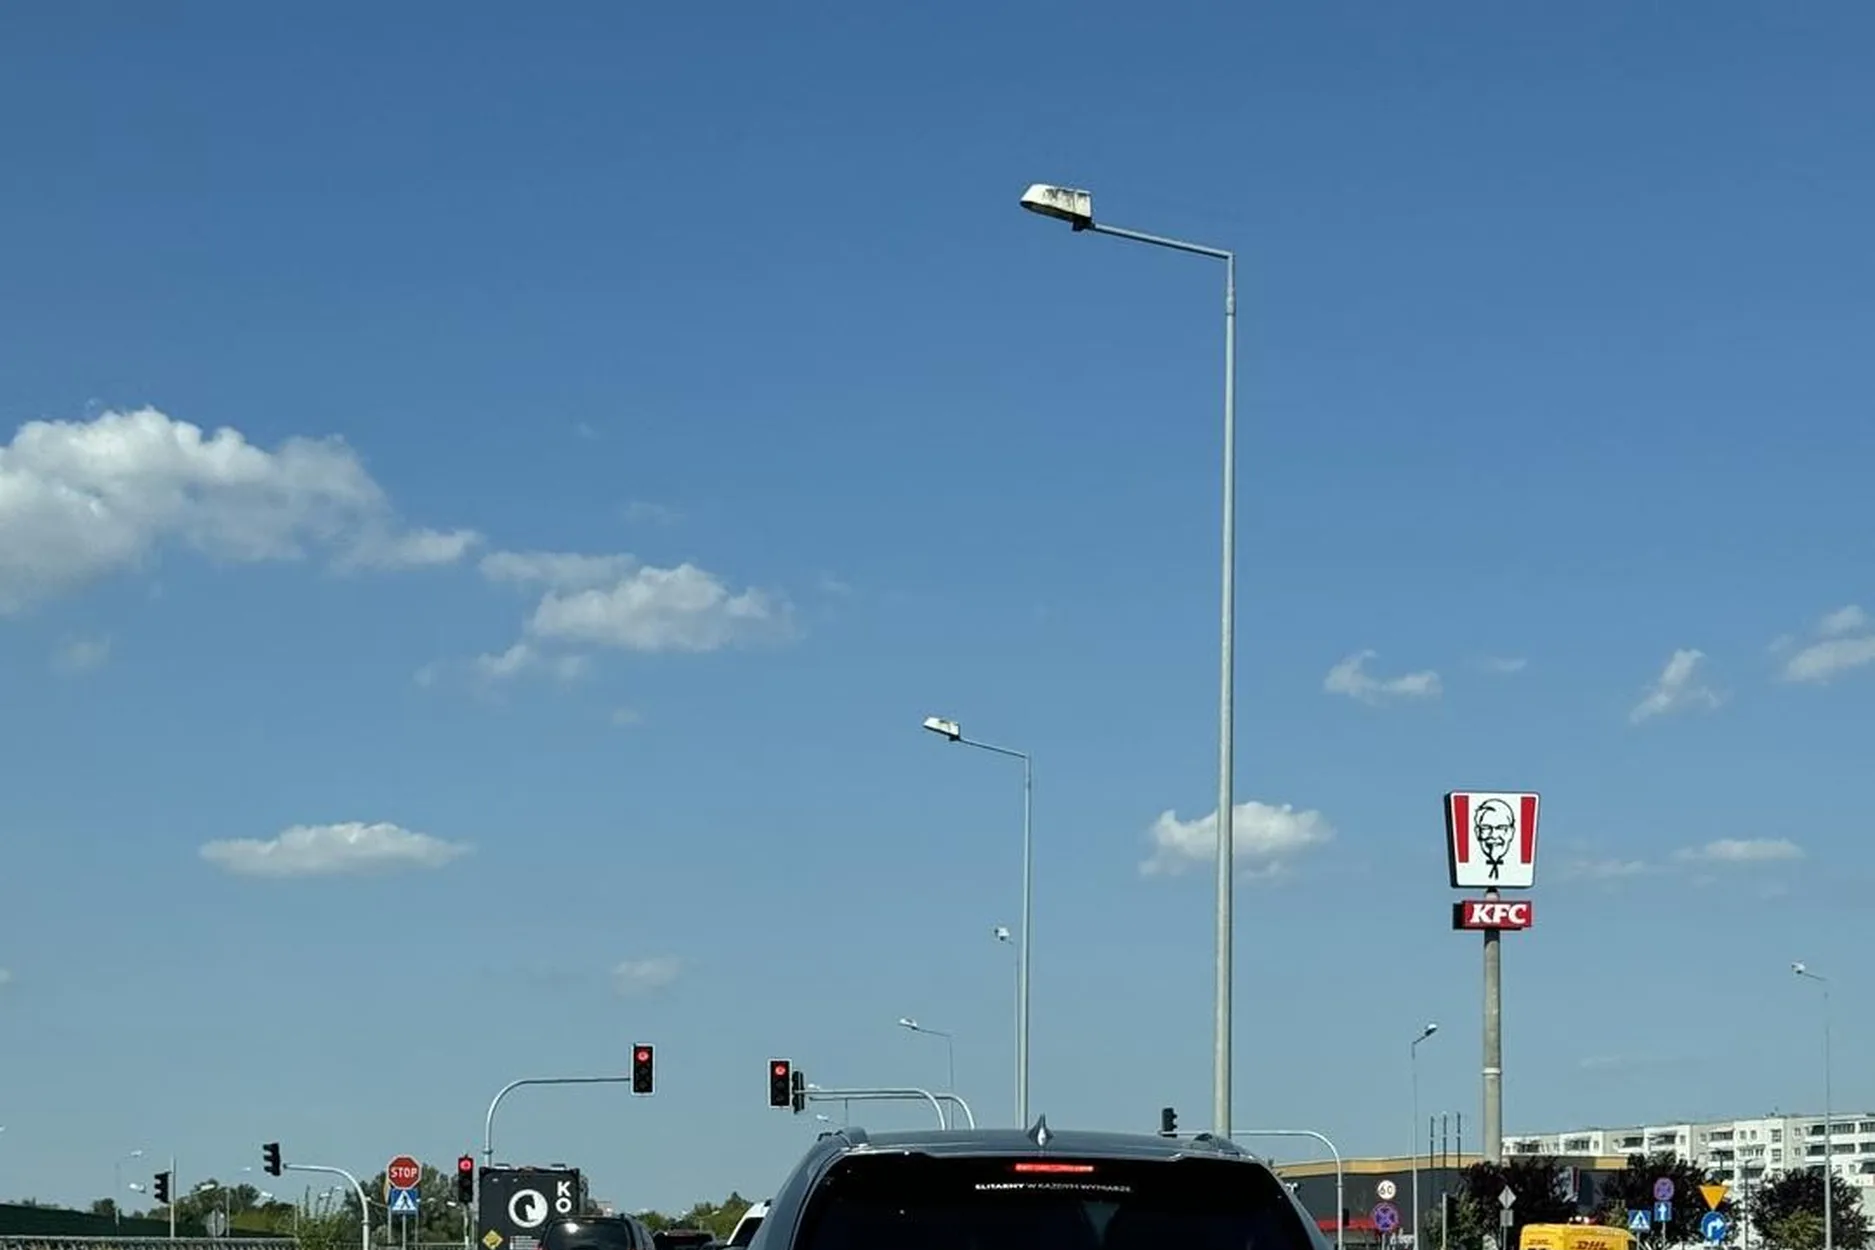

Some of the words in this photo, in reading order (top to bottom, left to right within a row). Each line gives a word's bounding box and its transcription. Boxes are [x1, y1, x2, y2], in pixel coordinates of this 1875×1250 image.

[1470, 903, 1527, 924] KFC
[390, 1167, 418, 1178] STOP
[1379, 1185, 1394, 1195] 60
